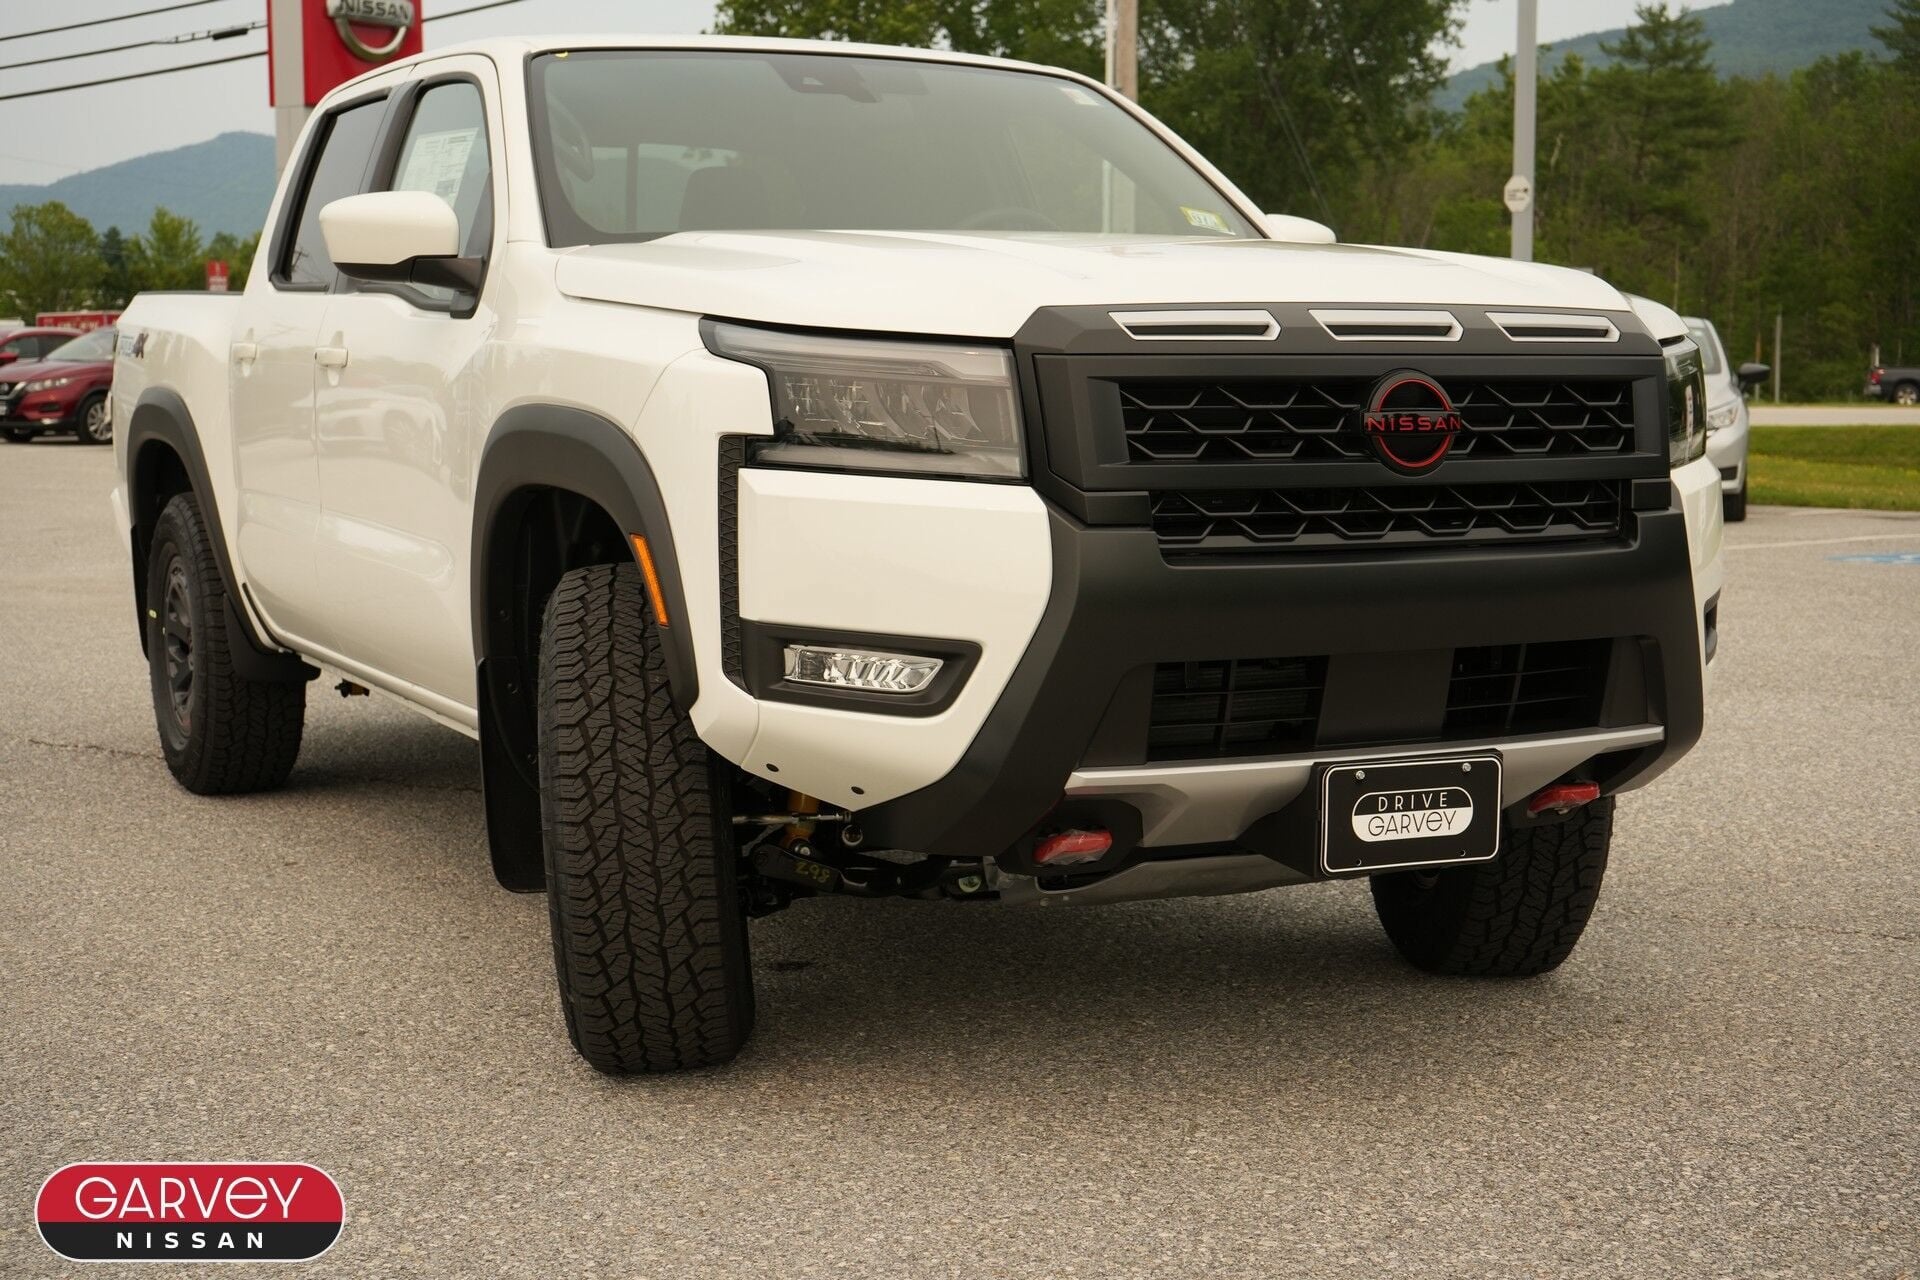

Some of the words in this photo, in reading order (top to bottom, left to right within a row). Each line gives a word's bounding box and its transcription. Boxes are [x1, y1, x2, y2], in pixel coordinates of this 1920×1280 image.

[335, 0, 409, 20] NISSAN
[1367, 416, 1461, 432] NISSAN
[1378, 792, 1448, 812] DRIVE
